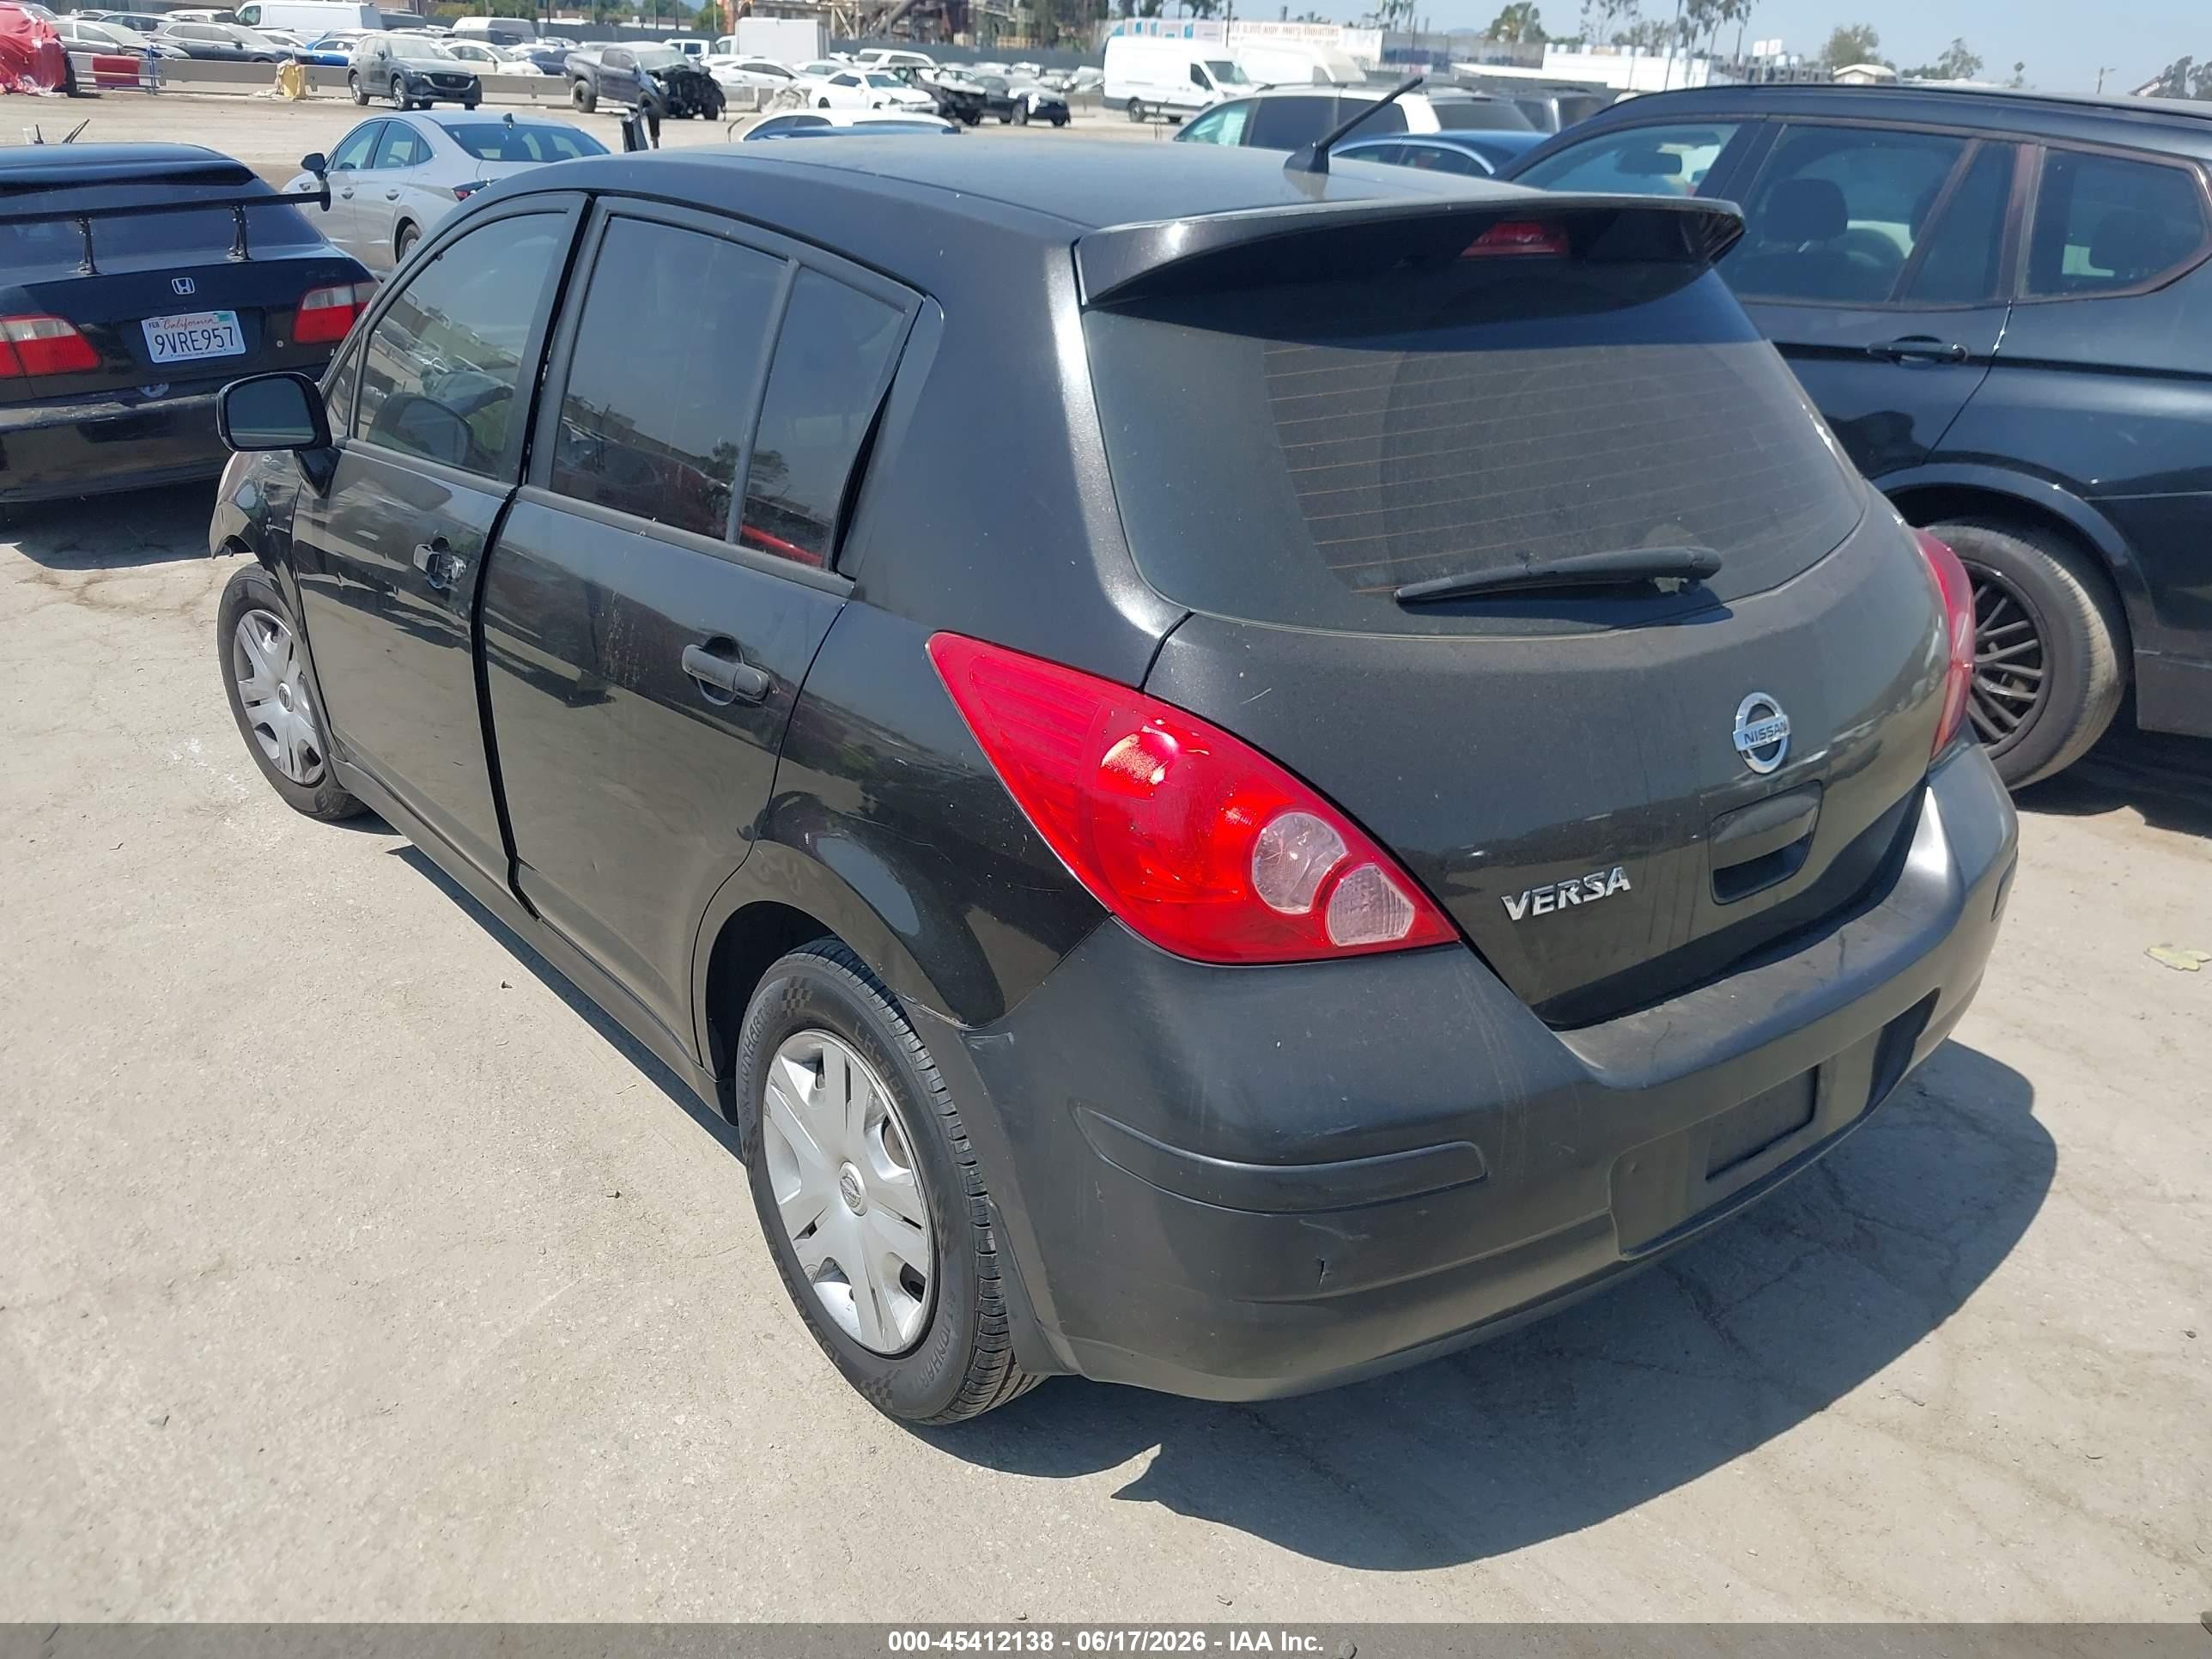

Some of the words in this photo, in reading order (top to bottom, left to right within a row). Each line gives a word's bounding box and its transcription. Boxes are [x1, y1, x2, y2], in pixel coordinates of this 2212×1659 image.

[163, 317, 219, 331] California
[155, 326, 234, 356] 9VRE957
[1743, 720, 1788, 744] NISSAN
[1501, 866, 1632, 921] VERSA
